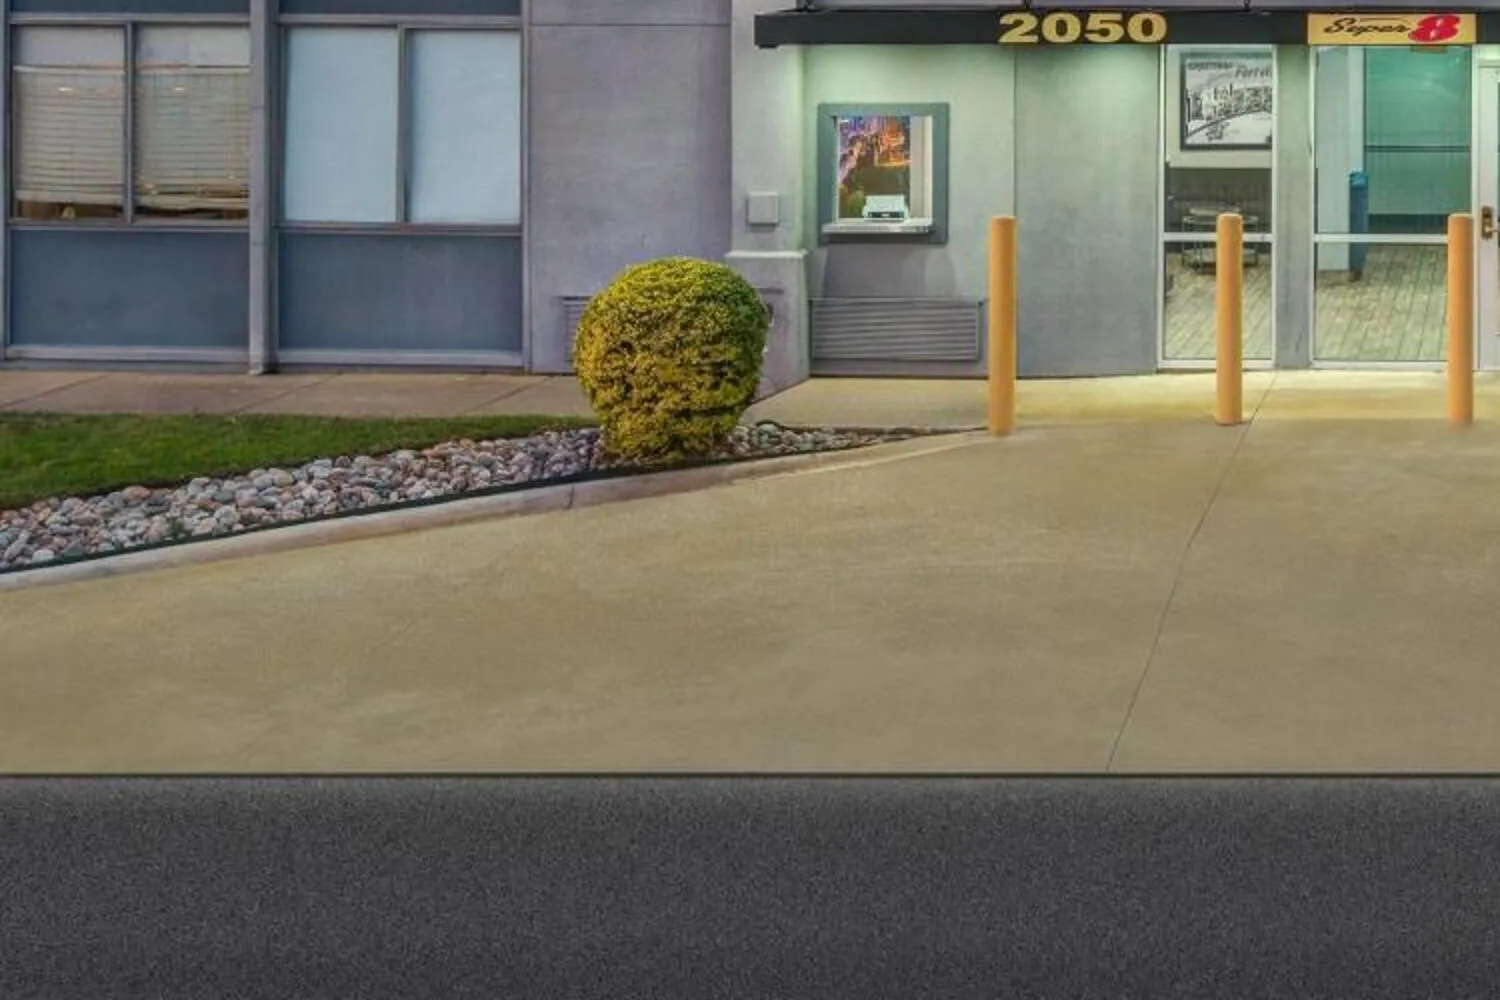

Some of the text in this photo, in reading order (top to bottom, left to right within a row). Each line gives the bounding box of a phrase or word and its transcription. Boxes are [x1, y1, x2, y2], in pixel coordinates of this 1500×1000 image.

[998, 12, 1167, 44] 2050
[1323, 12, 1462, 42] Super 8
